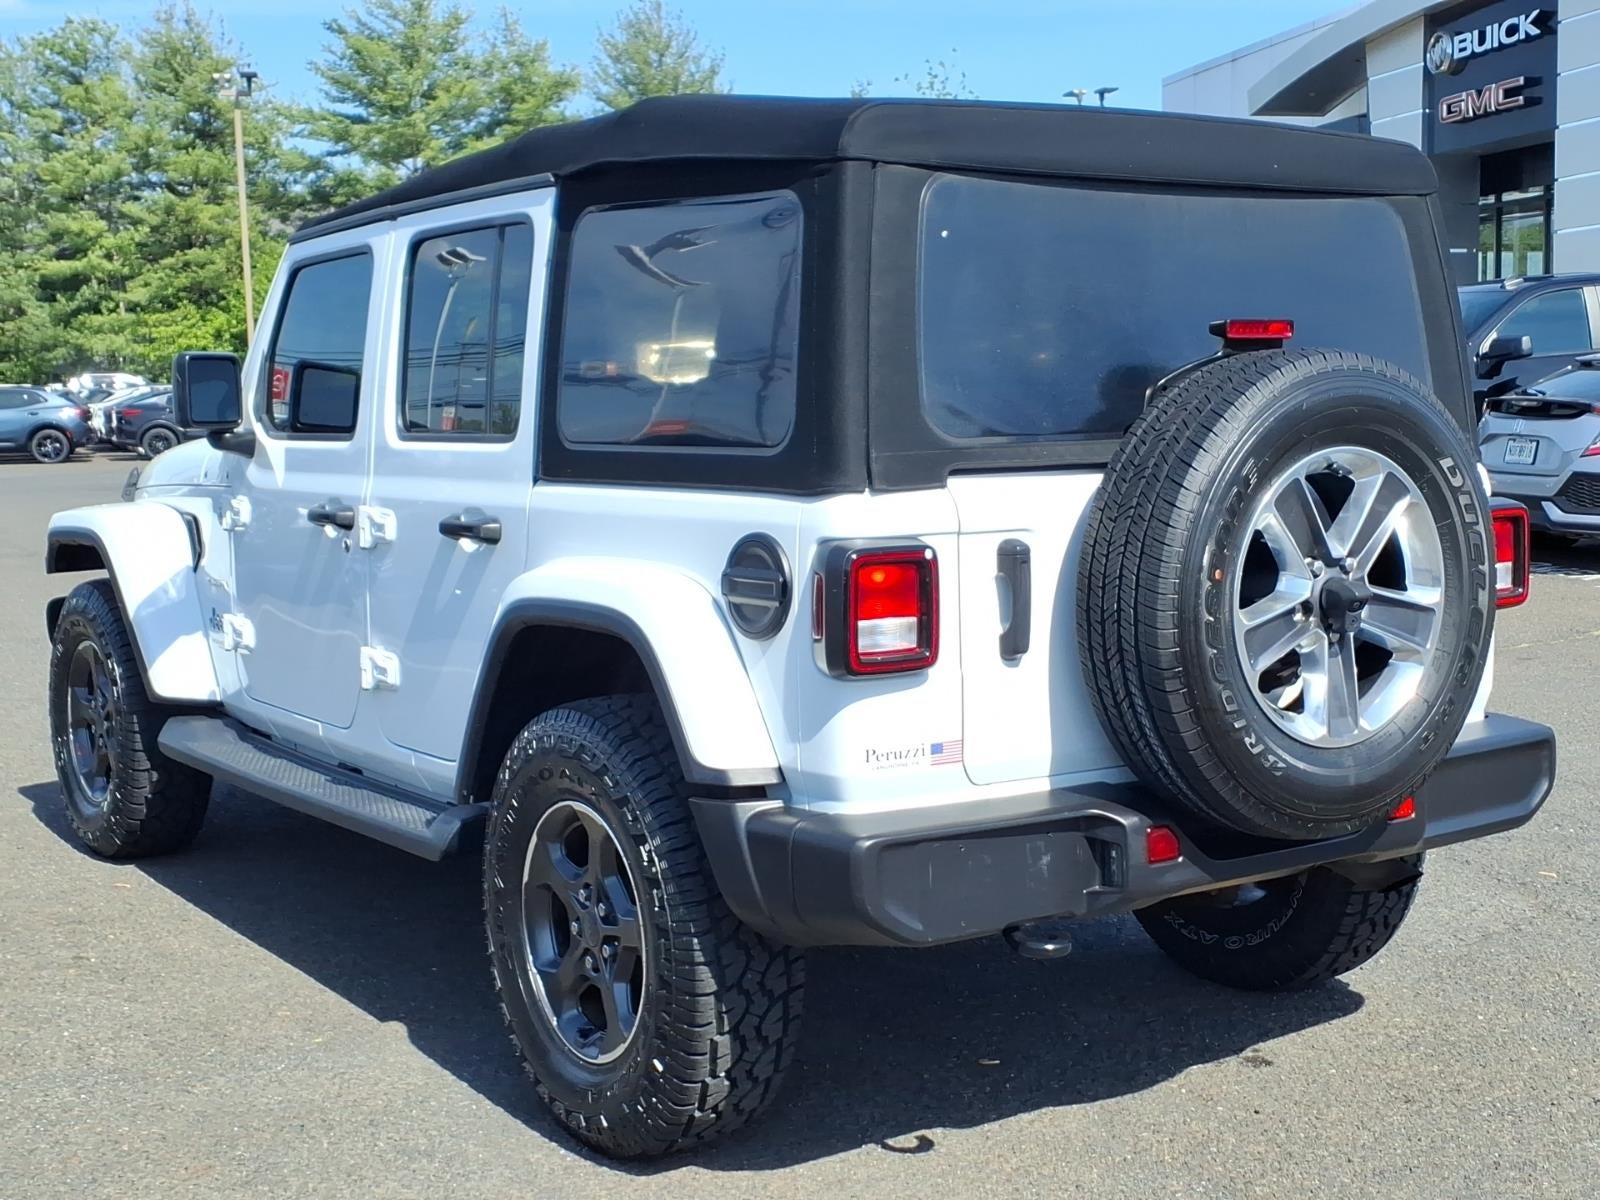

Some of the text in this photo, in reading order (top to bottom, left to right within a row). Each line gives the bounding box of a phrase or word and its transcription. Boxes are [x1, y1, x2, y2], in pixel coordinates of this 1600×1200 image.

[1453, 9, 1542, 60] BUICK
[1439, 76, 1525, 124] GMC
[1437, 456, 1488, 688] DUELER
[865, 743, 926, 764] Peruzzi
